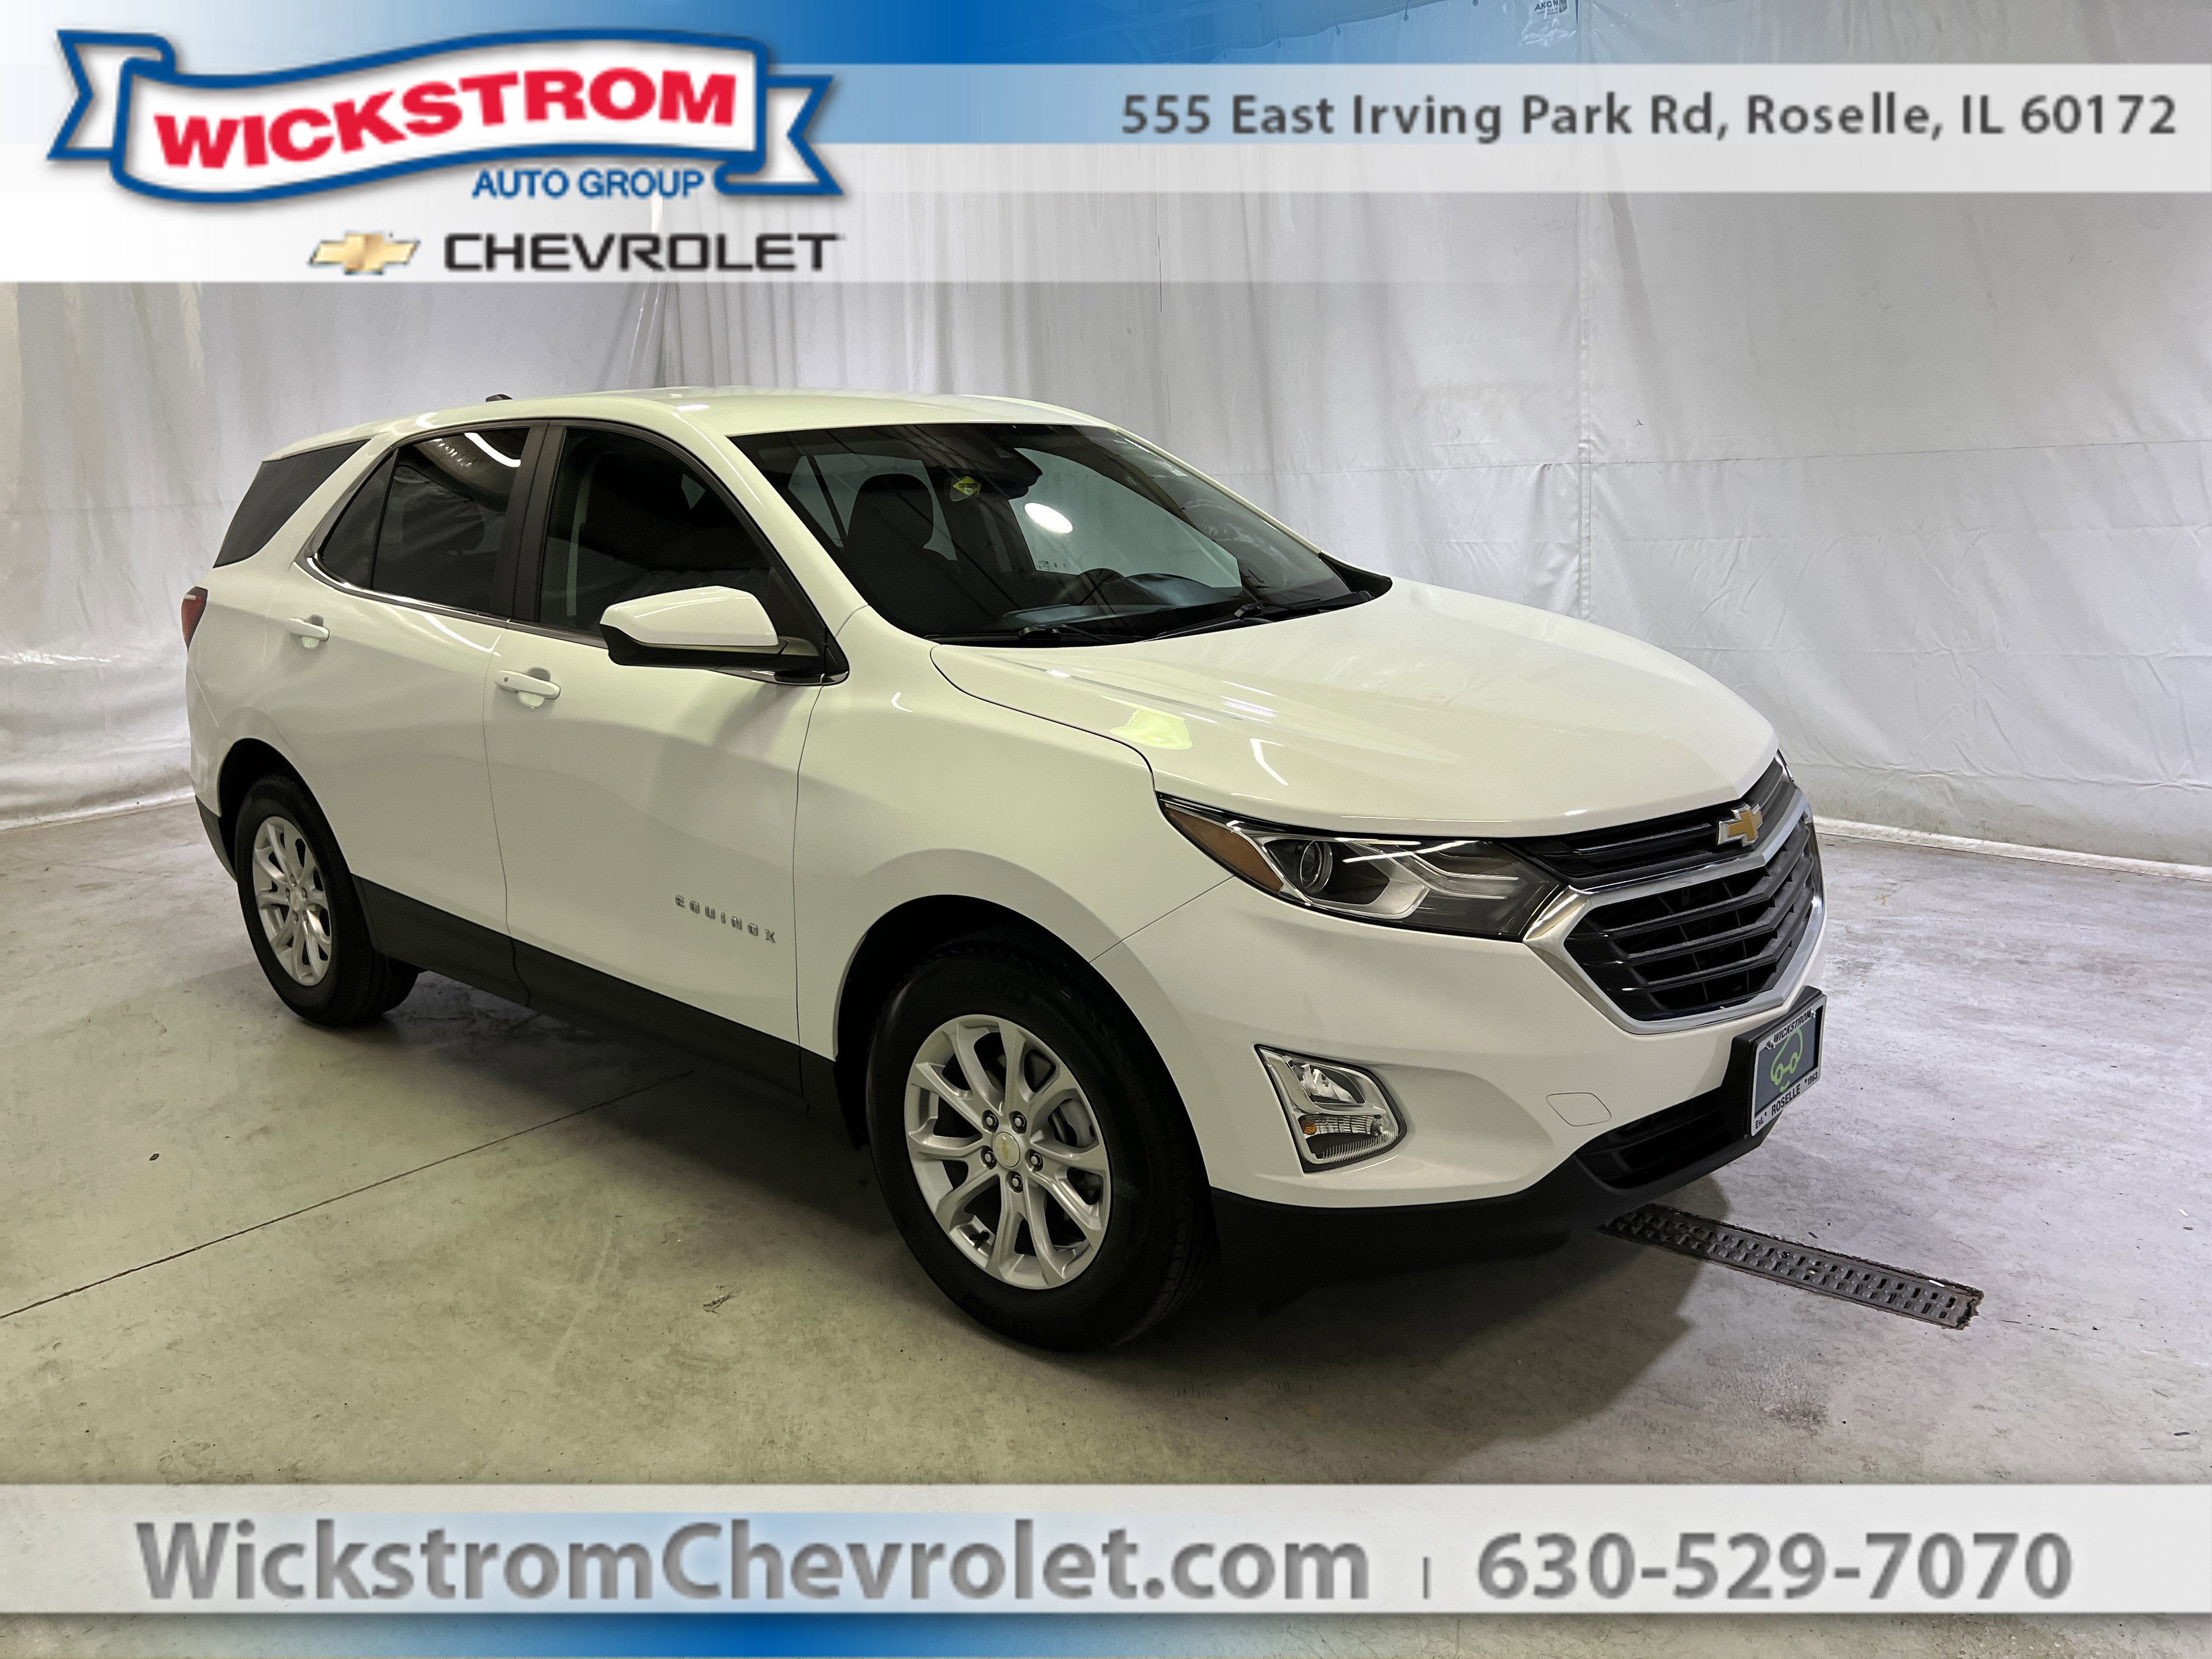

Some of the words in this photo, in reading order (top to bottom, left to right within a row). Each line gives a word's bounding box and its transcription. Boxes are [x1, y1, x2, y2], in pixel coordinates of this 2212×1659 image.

[675, 894, 776, 944] EQUINOX
[1773, 1008, 1812, 1043] WICKSTROM
[1771, 1084, 1801, 1116] ROSELLE
